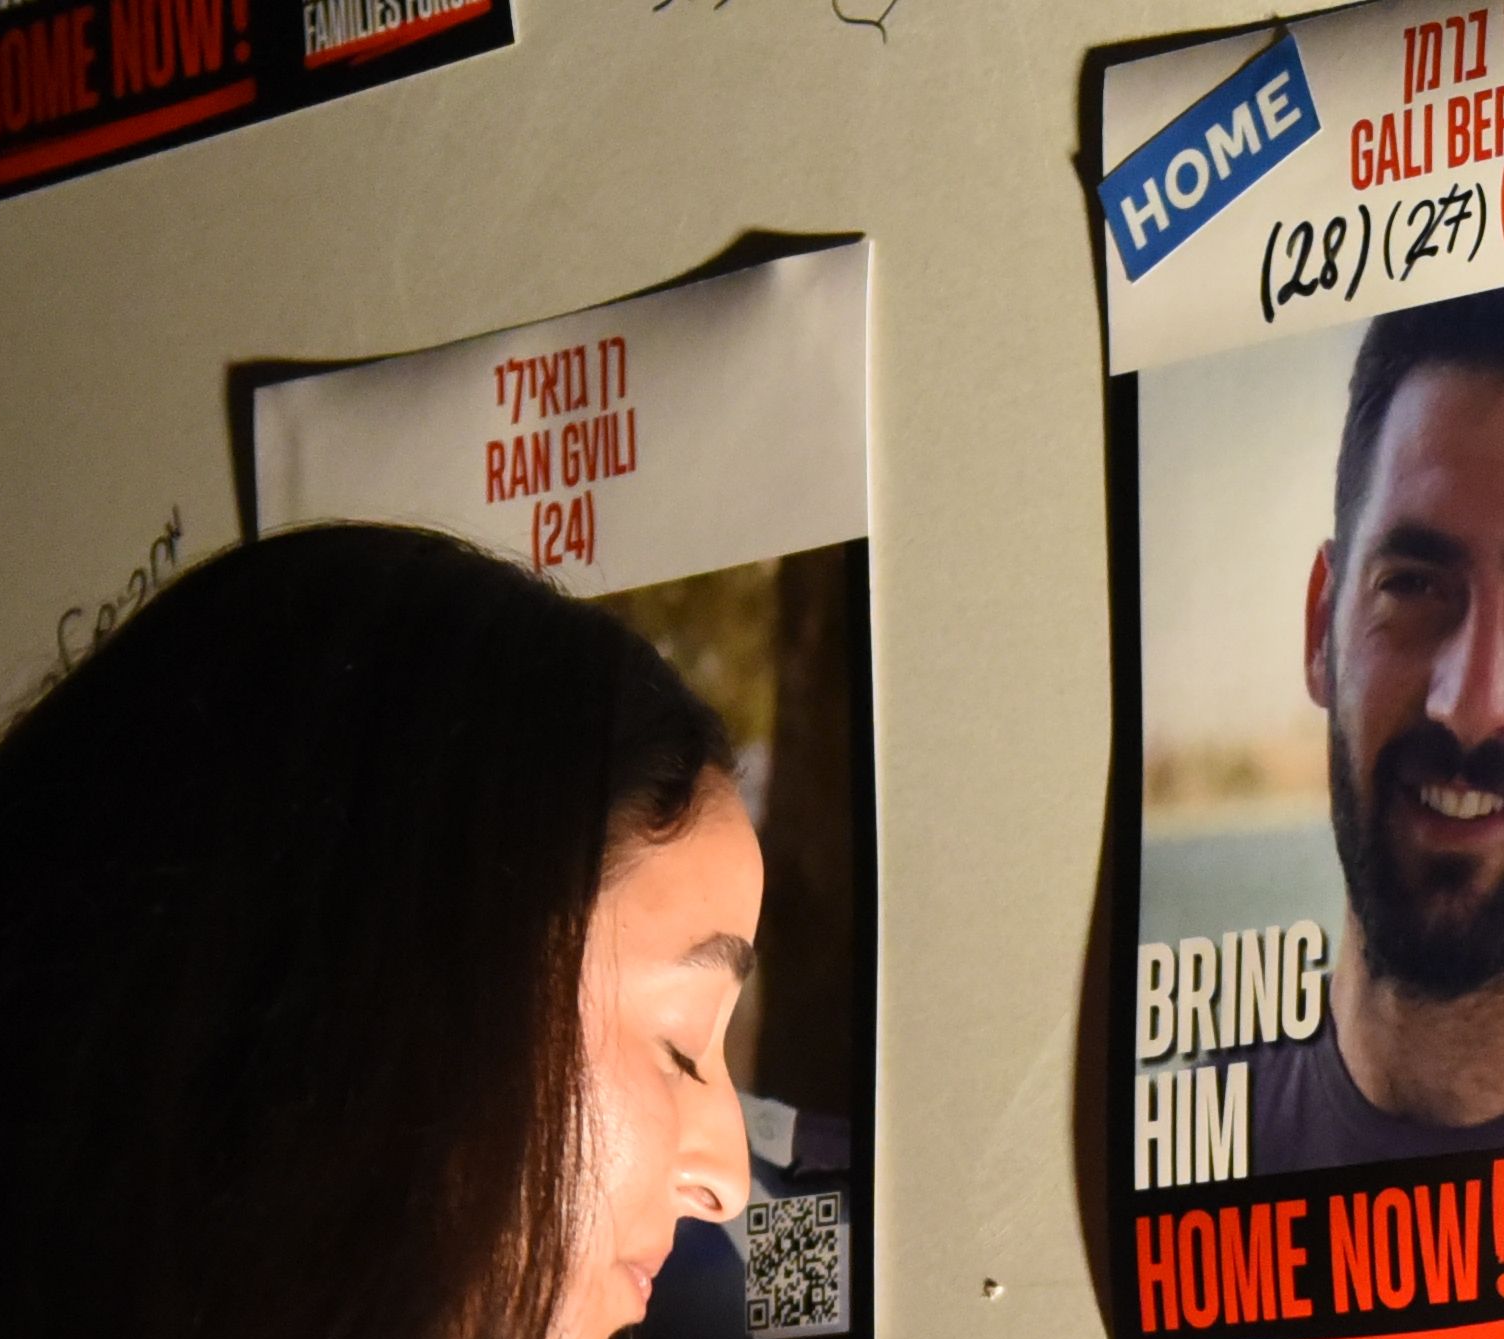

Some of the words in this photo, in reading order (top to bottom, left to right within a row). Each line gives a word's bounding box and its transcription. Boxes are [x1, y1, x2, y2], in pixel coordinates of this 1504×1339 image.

[1403, 9, 1489, 105] ברמן
[1120, 70, 1303, 253] HOME
[1349, 102, 1434, 191] GALI
[1259, 204, 1371, 324] (28)
[494, 344, 589, 425] גואילי
[599, 336, 626, 411] רן
[486, 428, 551, 504] RAN
[561, 407, 636, 488] GVILI
[532, 490, 595, 575] (24)
[1136, 919, 1324, 1060] BRING
[1134, 1061, 1250, 1191] HIM
[1135, 1199, 1314, 1334] HOME
